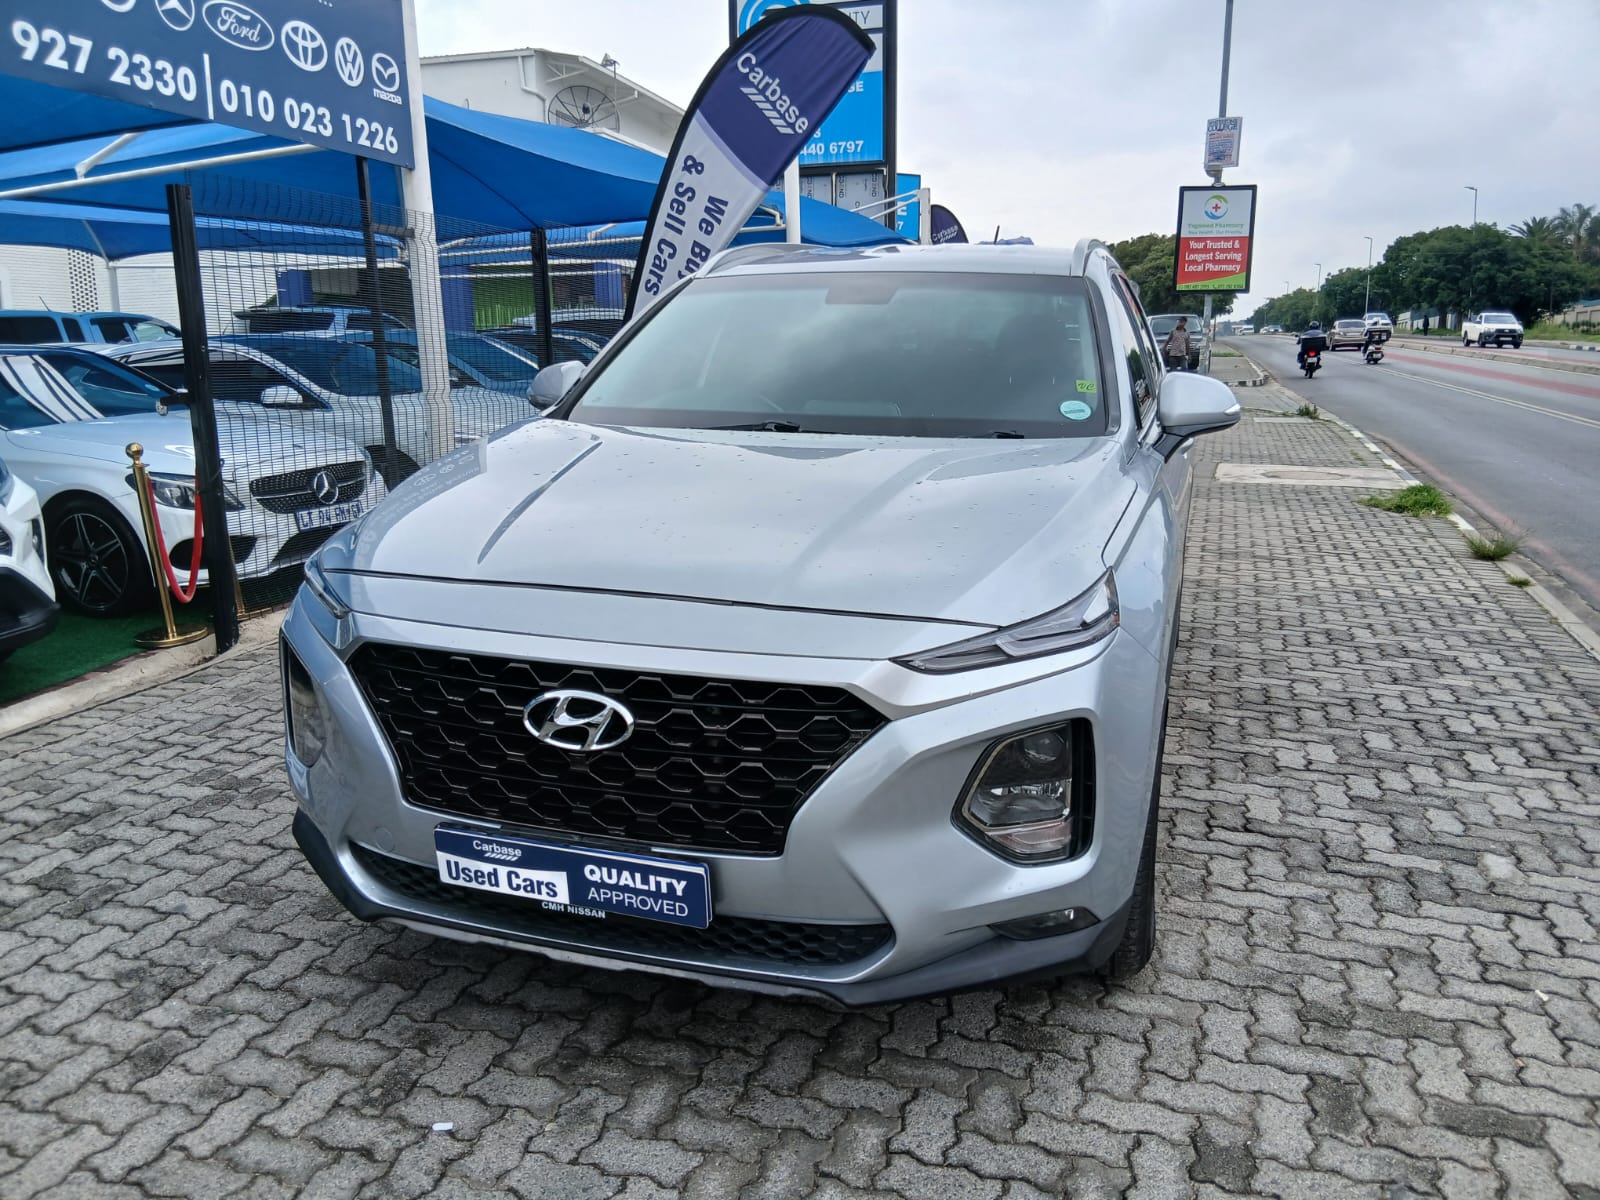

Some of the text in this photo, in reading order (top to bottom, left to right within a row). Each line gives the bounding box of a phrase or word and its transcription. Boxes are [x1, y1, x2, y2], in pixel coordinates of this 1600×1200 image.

[216, 6, 261, 42] Ford
[12, 20, 399, 154] 927 2330 010 023 1226
[372, 88, 402, 105] mazda
[737, 52, 809, 134] Carbase
[829, 140, 864, 154] 6797
[644, 154, 705, 296] & Sell Cars
[698, 195, 729, 236] We
[1185, 251, 1242, 262] Longest Serving
[1189, 239, 1240, 249] Your Trusted &
[1184, 262, 1241, 273] Local Pharmacy
[473, 839, 522, 857] Carbase
[445, 858, 558, 899] Used Cars
[584, 864, 688, 897] QUALITY
[541, 901, 606, 918] CMH NISSAN
[587, 887, 688, 917] APPROVED
